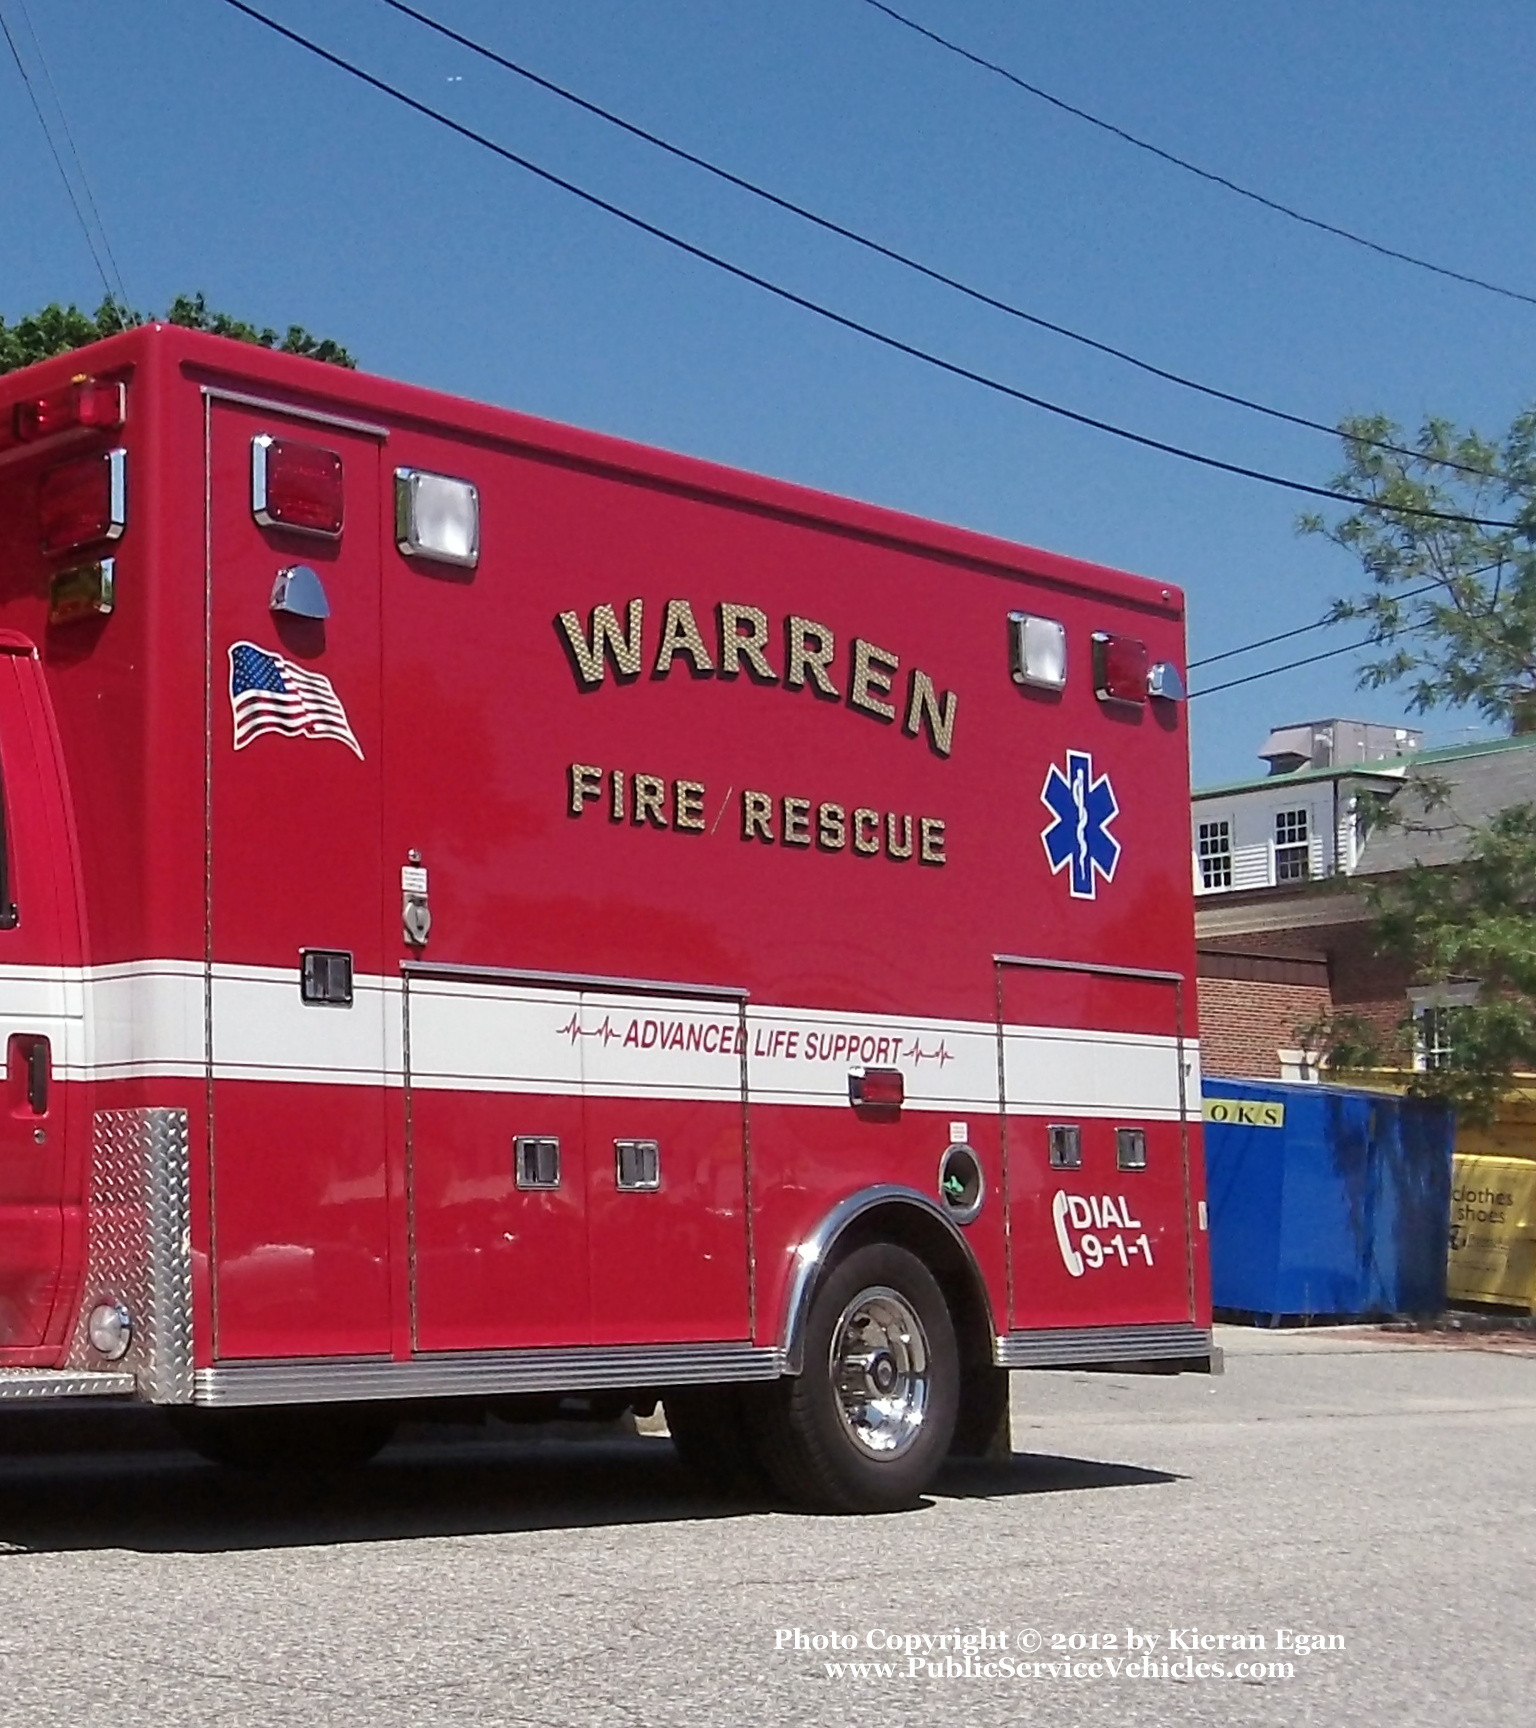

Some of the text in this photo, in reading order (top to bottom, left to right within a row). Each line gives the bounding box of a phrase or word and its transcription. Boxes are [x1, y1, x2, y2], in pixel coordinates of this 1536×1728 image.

[554, 597, 959, 759] WARREN
[623, 1019, 904, 1064] ADVANCED LIFE SUPPORT
[1210, 1104, 1278, 1126] OKS
[1066, 1195, 1142, 1229] DIAL
[1452, 1184, 1514, 1206] clothes
[1457, 1204, 1506, 1224] shoes
[1080, 1233, 1155, 1268] 9-1-1
